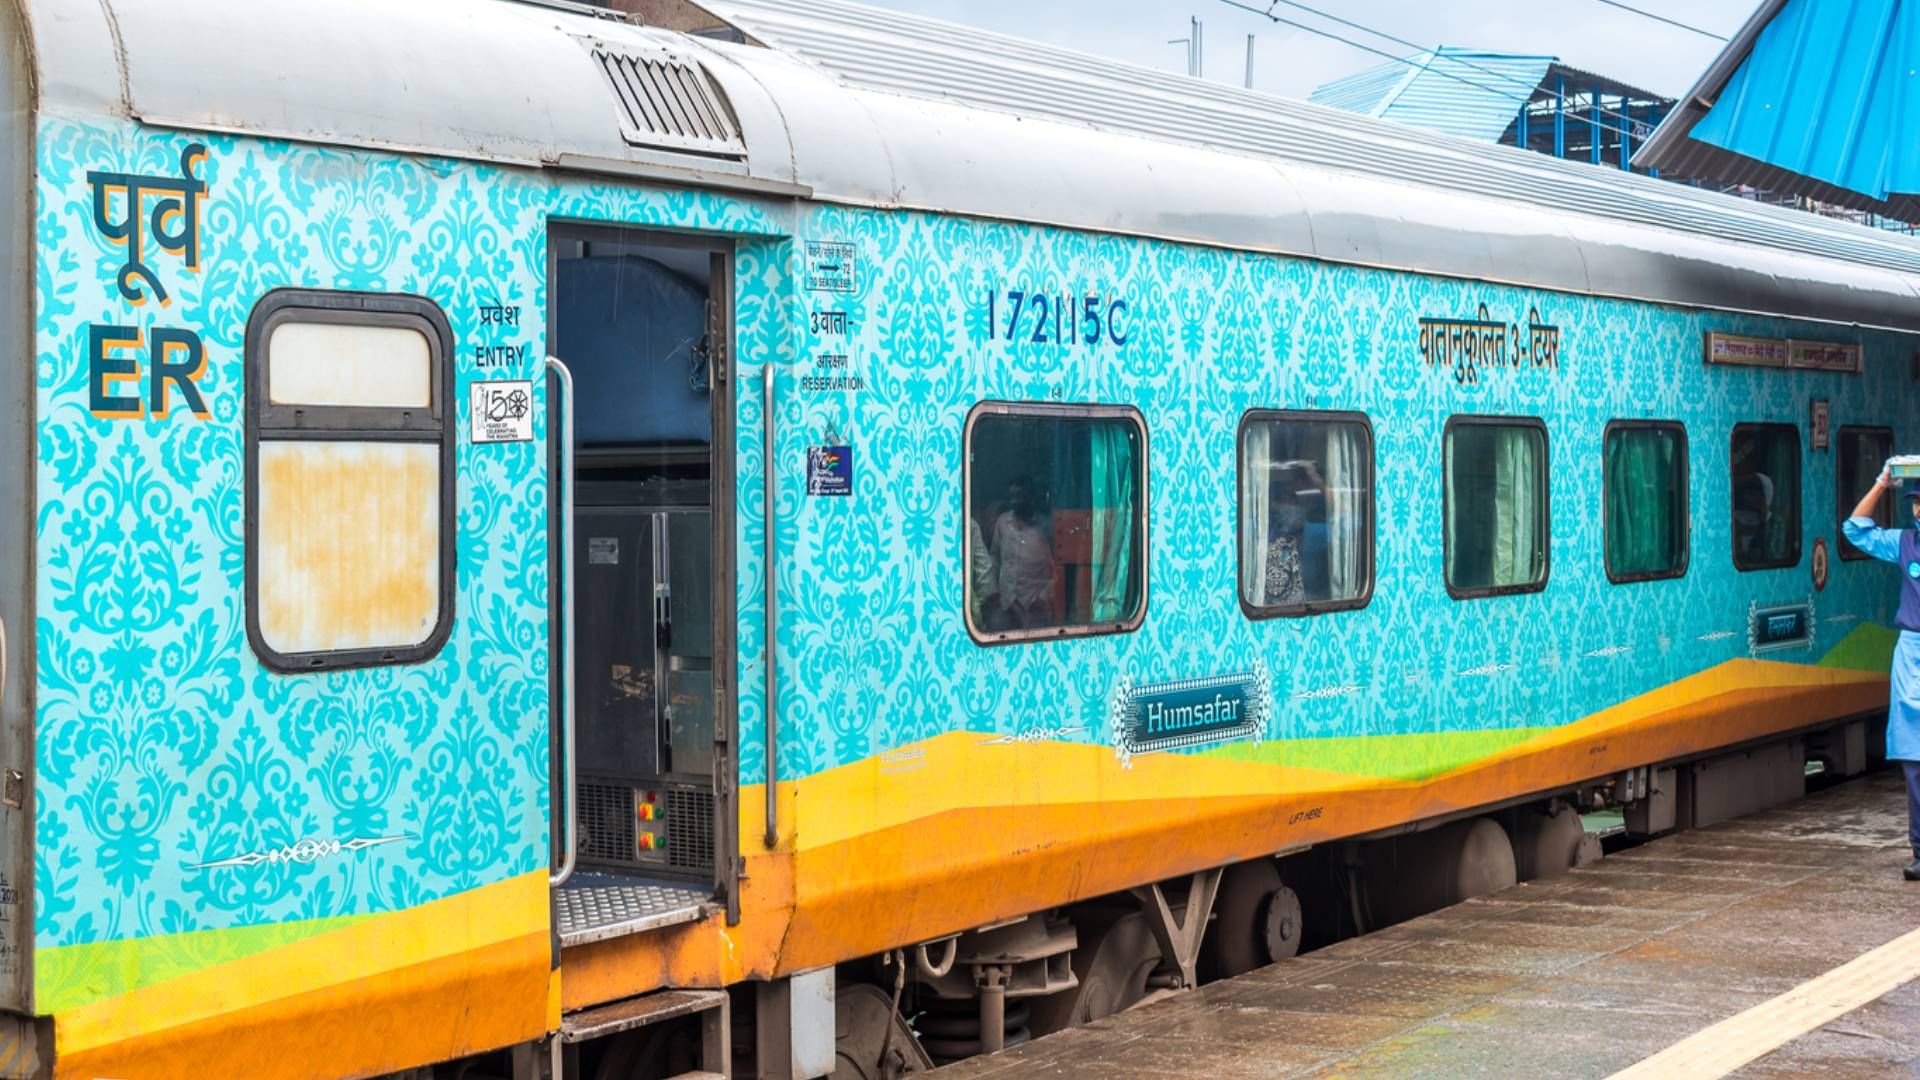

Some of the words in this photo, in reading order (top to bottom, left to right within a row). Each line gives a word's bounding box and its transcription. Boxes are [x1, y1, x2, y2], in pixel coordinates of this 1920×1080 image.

[87, 143, 209, 308] पूर्व
[480, 298, 520, 325] प्रवेश
[989, 289, 1127, 346] 172115C
[475, 346, 525, 367] ENTRY
[1418, 302, 1507, 384] वातानुकूलित
[88, 324, 213, 420] ER
[802, 376, 864, 391] RESERVATION
[1147, 693, 1240, 733] Humsafar
[1289, 811, 1305, 825] LIFT
[1305, 806, 1325, 821] HERE
